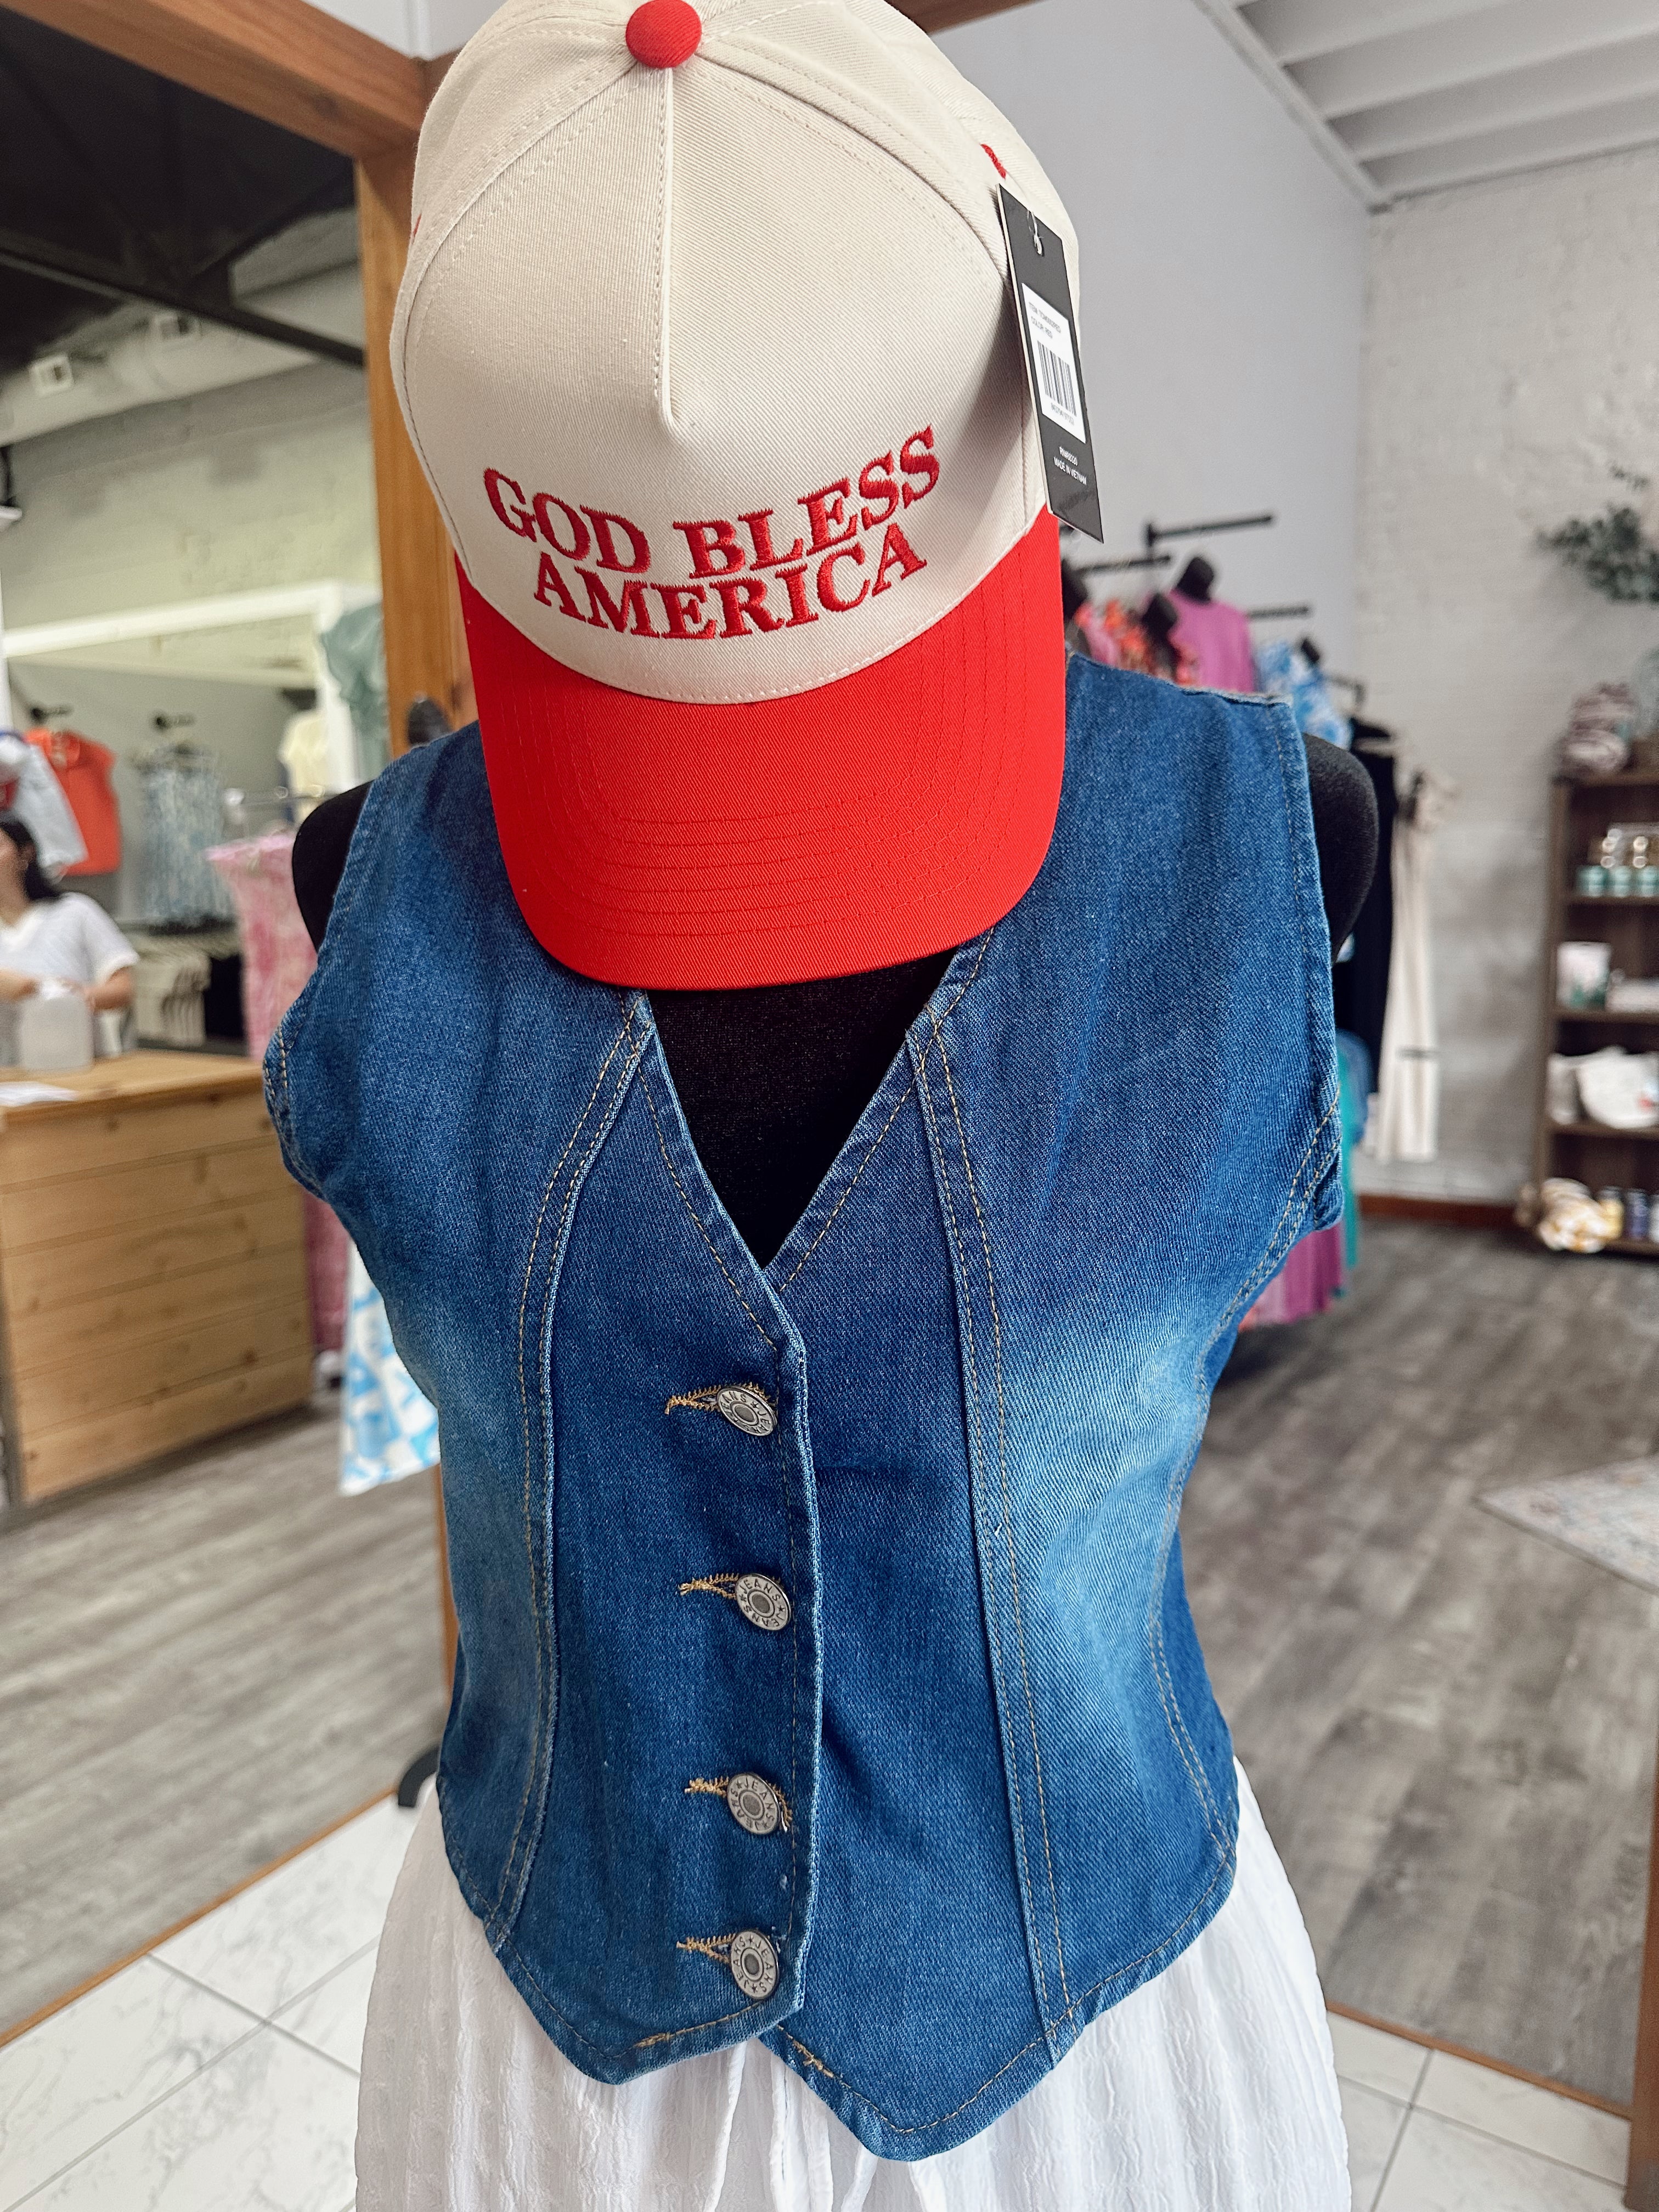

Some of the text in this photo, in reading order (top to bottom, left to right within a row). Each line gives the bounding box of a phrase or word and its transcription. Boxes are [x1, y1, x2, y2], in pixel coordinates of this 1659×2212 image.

[483, 423, 941, 579] GOD BLESS
[1053, 456, 1087, 486] MADE IN VIETNAM
[533, 522, 928, 640] AMERICA
